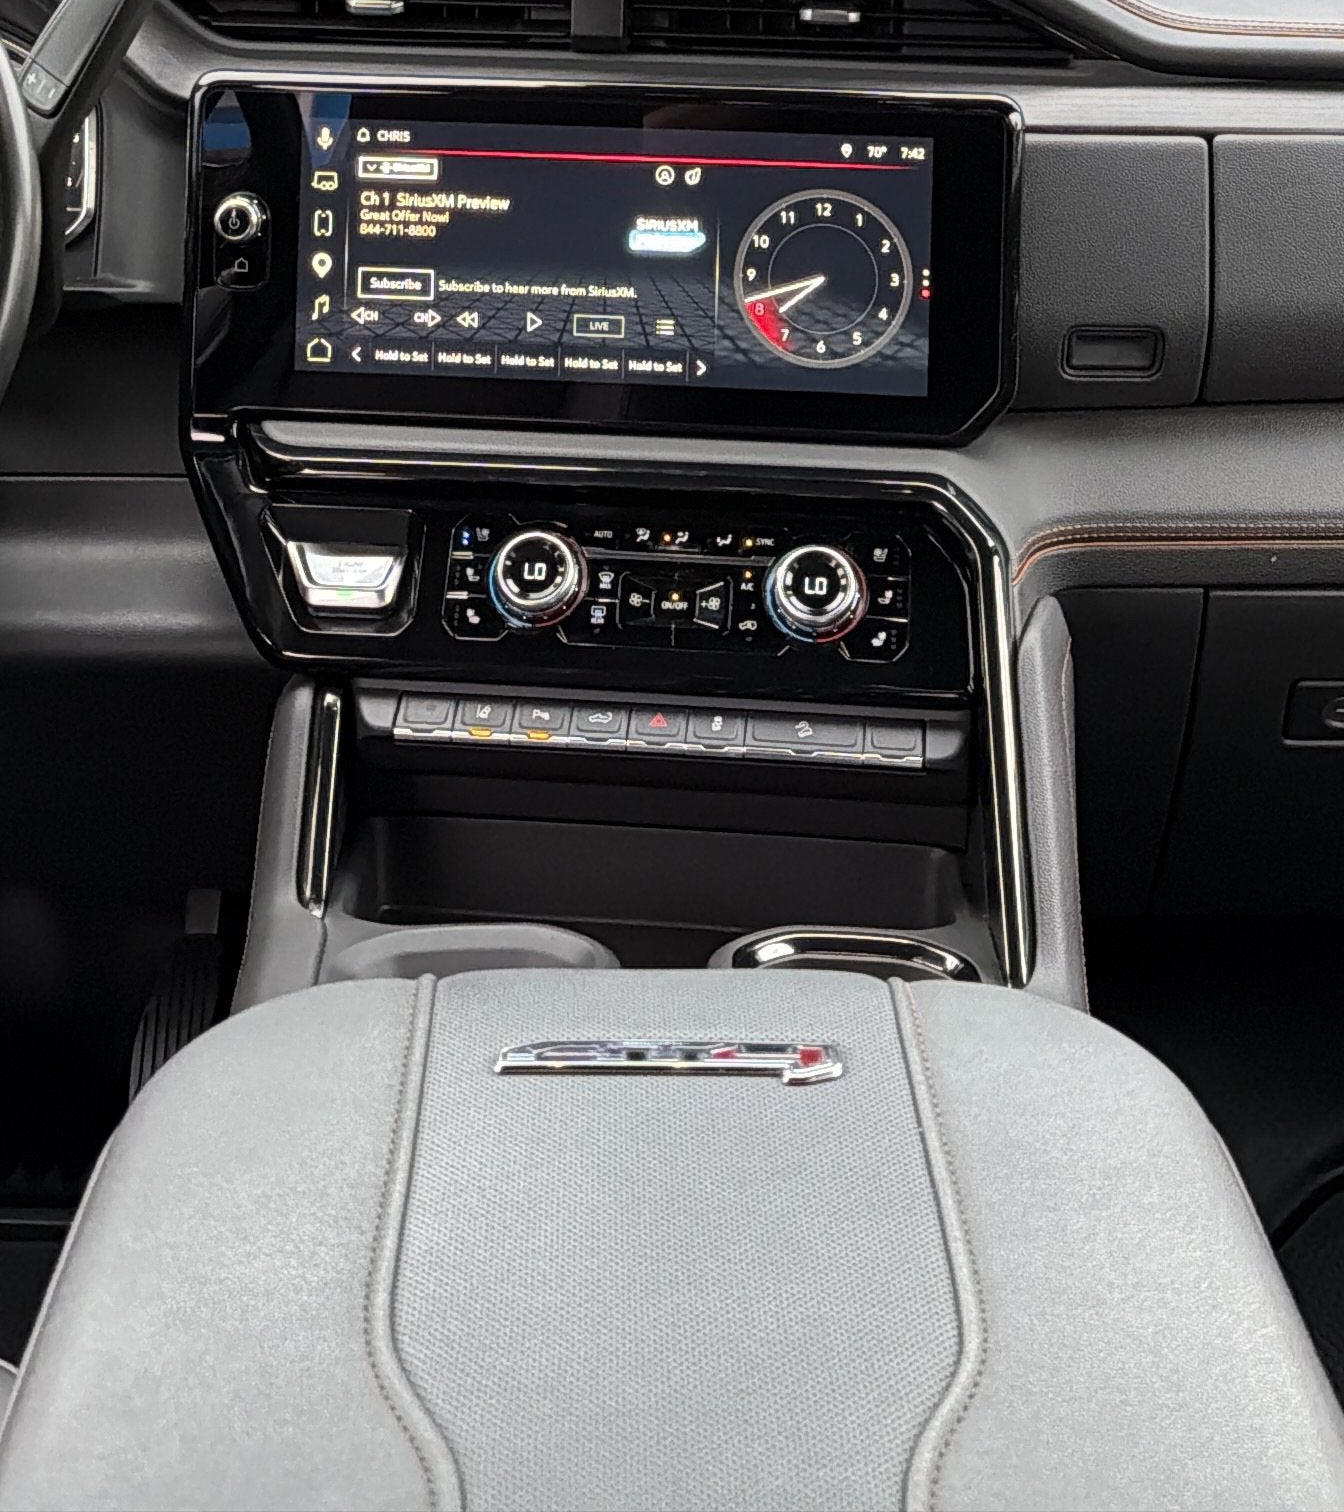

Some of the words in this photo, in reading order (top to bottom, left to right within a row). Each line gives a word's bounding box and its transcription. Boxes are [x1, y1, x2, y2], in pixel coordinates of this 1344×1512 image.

[377, 130, 411, 143] CHRIS
[900, 146, 925, 160] 7:42
[360, 191, 380, 206] Ch
[382, 191, 390, 206] 1
[396, 193, 454, 208] SiriusXM
[457, 194, 511, 210] Preview
[360, 209, 390, 221] Great
[392, 210, 421, 222] Offer
[816, 202, 832, 218] 12
[636, 217, 699, 232] SIRIUSXM
[780, 211, 795, 225] 11
[856, 213, 863, 227] 1
[359, 224, 436, 237] 844-711-8800
[753, 234, 770, 249] 10
[881, 239, 890, 253] 2
[746, 267, 756, 281] 9
[890, 272, 900, 287] 3
[369, 276, 422, 290] Subscribe
[438, 280, 489, 293] Subscribe
[491, 282, 503, 293] to
[505, 281, 529, 294] hear
[531, 286, 558, 296] more
[560, 284, 586, 297] from
[364, 310, 378, 322] CH
[754, 302, 765, 316] 8
[878, 307, 888, 321] 4
[414, 312, 428, 323] CH
[589, 321, 609, 331] LIVE
[780, 328, 790, 342] 7
[852, 331, 862, 346] 5
[816, 340, 826, 354] 6
[375, 349, 398, 361] Hold
[400, 351, 410, 361] to
[412, 351, 428, 362] Set
[438, 351, 461, 363] Hold
[463, 353, 474, 364] to
[475, 353, 491, 365] Set
[501, 354, 524, 366] Hold
[526, 355, 537, 366] to
[538, 355, 555, 367] Set
[564, 356, 588, 369] Hold
[589, 358, 600, 369] to
[601, 358, 618, 370] Set
[628, 360, 652, 371] Hold
[653, 361, 664, 372] to
[665, 361, 682, 373] Set
[594, 530, 613, 538] AUTO
[756, 538, 775, 547] SYNC
[740, 582, 755, 592] A/C
[661, 601, 689, 611] ON/OFF
